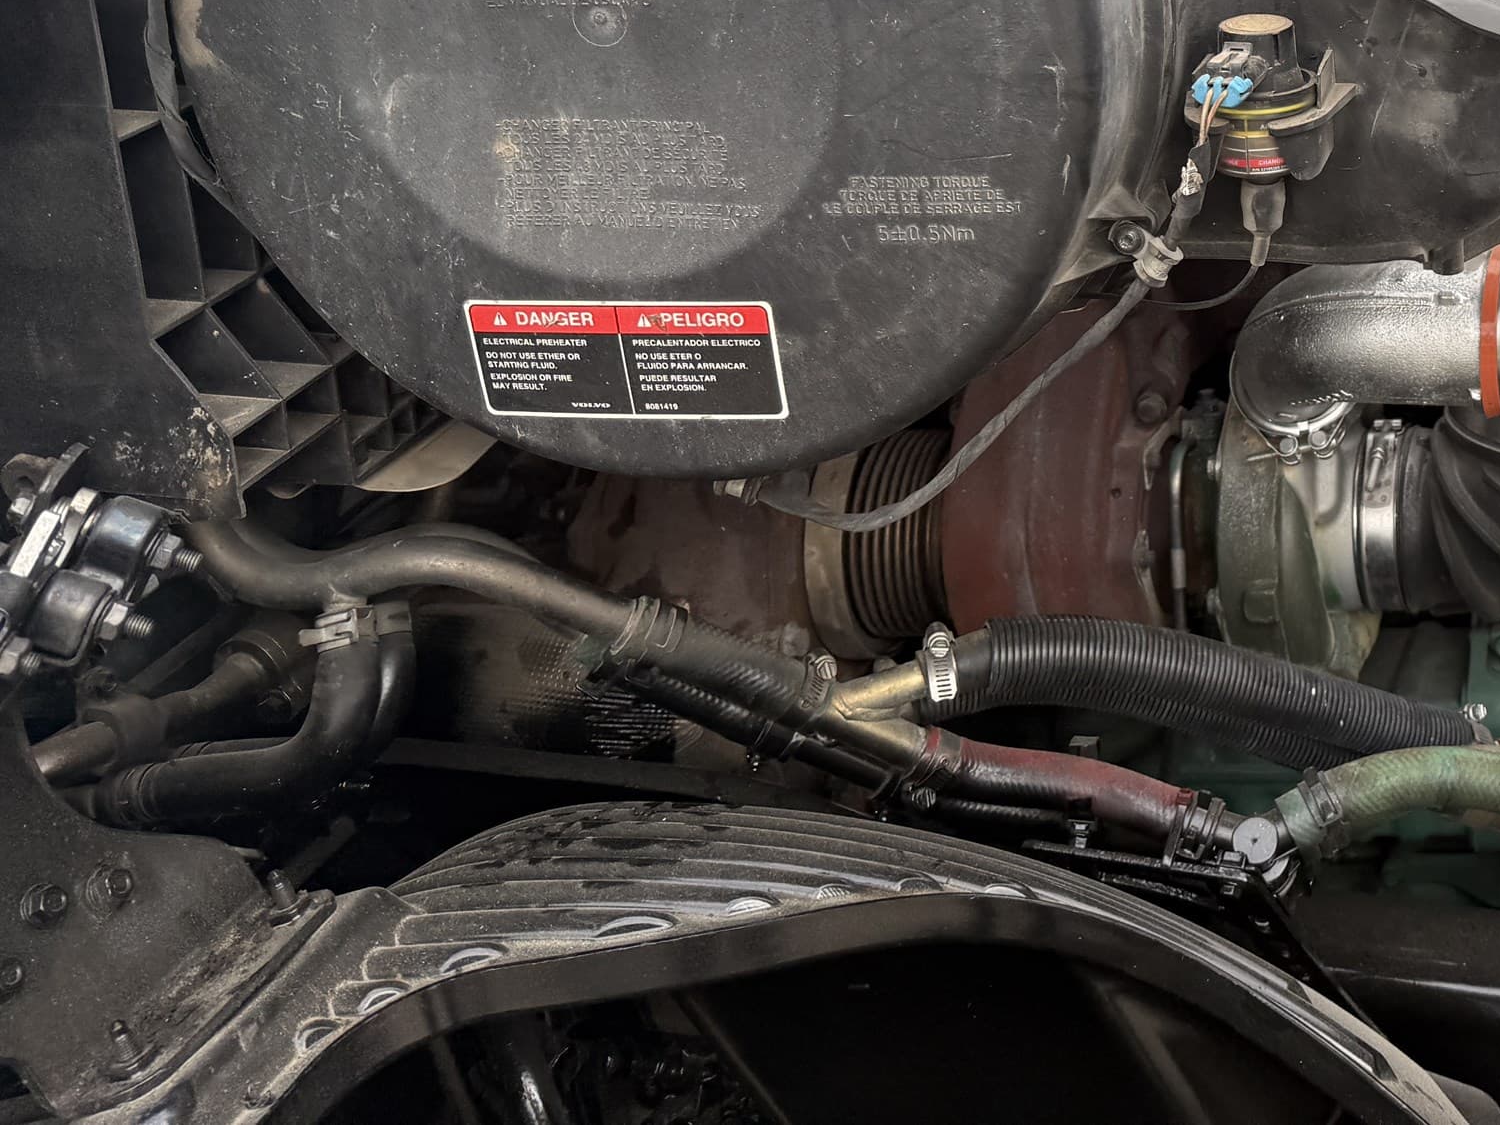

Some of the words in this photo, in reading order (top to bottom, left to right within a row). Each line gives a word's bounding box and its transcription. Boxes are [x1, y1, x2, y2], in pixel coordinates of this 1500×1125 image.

[849, 175, 930, 189] FASTENING
[934, 175, 992, 189] TORQUE
[838, 189, 898, 203] TORQUE
[901, 189, 919, 202] DE
[986, 188, 1006, 201] DE
[824, 202, 844, 216] LE
[847, 202, 900, 215] COUPLE
[904, 203, 922, 215] DE
[926, 202, 992, 216] SERRAGE
[996, 201, 1023, 214] EST
[515, 311, 595, 327] DANGER
[660, 312, 745, 328] PELIGRO
[482, 337, 535, 346] ELECTRICAL
[536, 338, 588, 347] PREHEATER
[632, 339, 709, 347] PRECALENTADOR
[711, 339, 761, 347] ELECTRICO
[485, 351, 498, 360] DO
[500, 351, 517, 360] NOT
[519, 352, 536, 360] USE
[538, 352, 566, 361] ETHER
[567, 353, 581, 361] OR
[670, 353, 693, 361] ETER
[694, 353, 702, 361] O
[488, 361, 530, 369] STARTING
[531, 361, 558, 370] FLUID.
[637, 362, 669, 370] FLUIDO
[670, 362, 695, 370] PARA
[697, 362, 749, 370] ARRANCAR.
[490, 373, 538, 381] EXPLOSION
[539, 373, 552, 382] OR
[554, 374, 573, 382] FIRE
[671, 374, 717, 383] RESULTAR
[492, 382, 511, 390] MAY
[512, 383, 548, 391] RESULT.
[655, 383, 708, 392] EXPLOSION.
[571, 401, 612, 409] VOLVO
